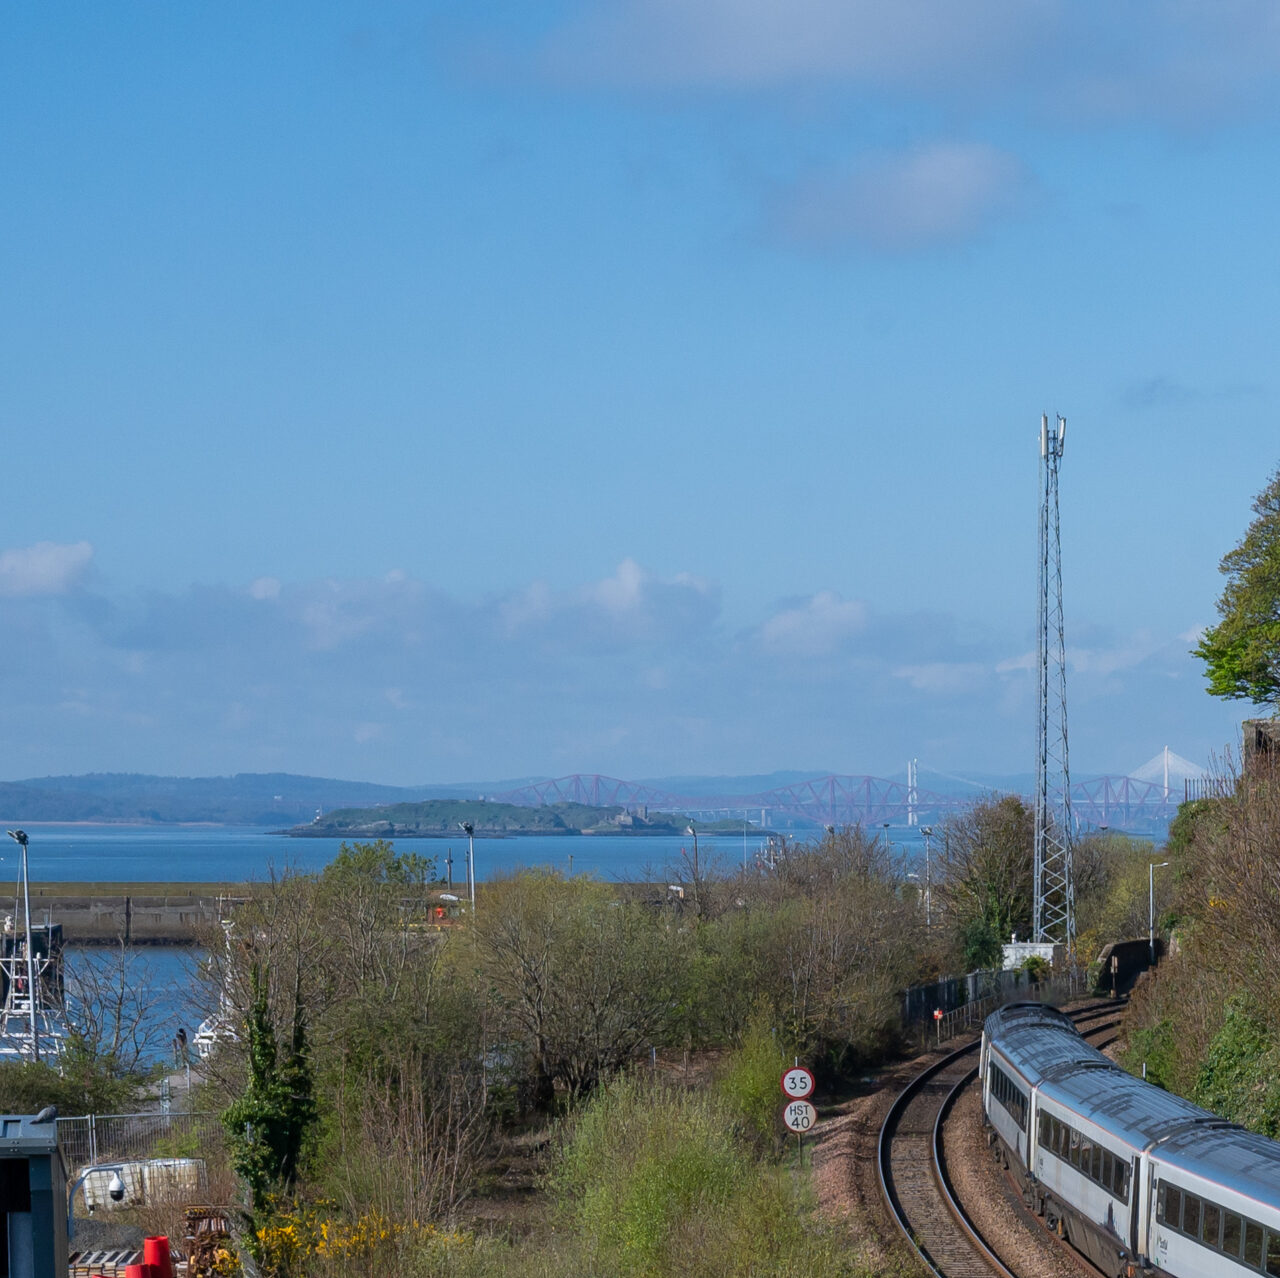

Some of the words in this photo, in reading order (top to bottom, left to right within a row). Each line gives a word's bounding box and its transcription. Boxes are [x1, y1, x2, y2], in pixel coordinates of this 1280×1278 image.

[788, 1077, 808, 1090] 35
[790, 1105, 810, 1116] HST
[791, 1117, 810, 1129] 40
